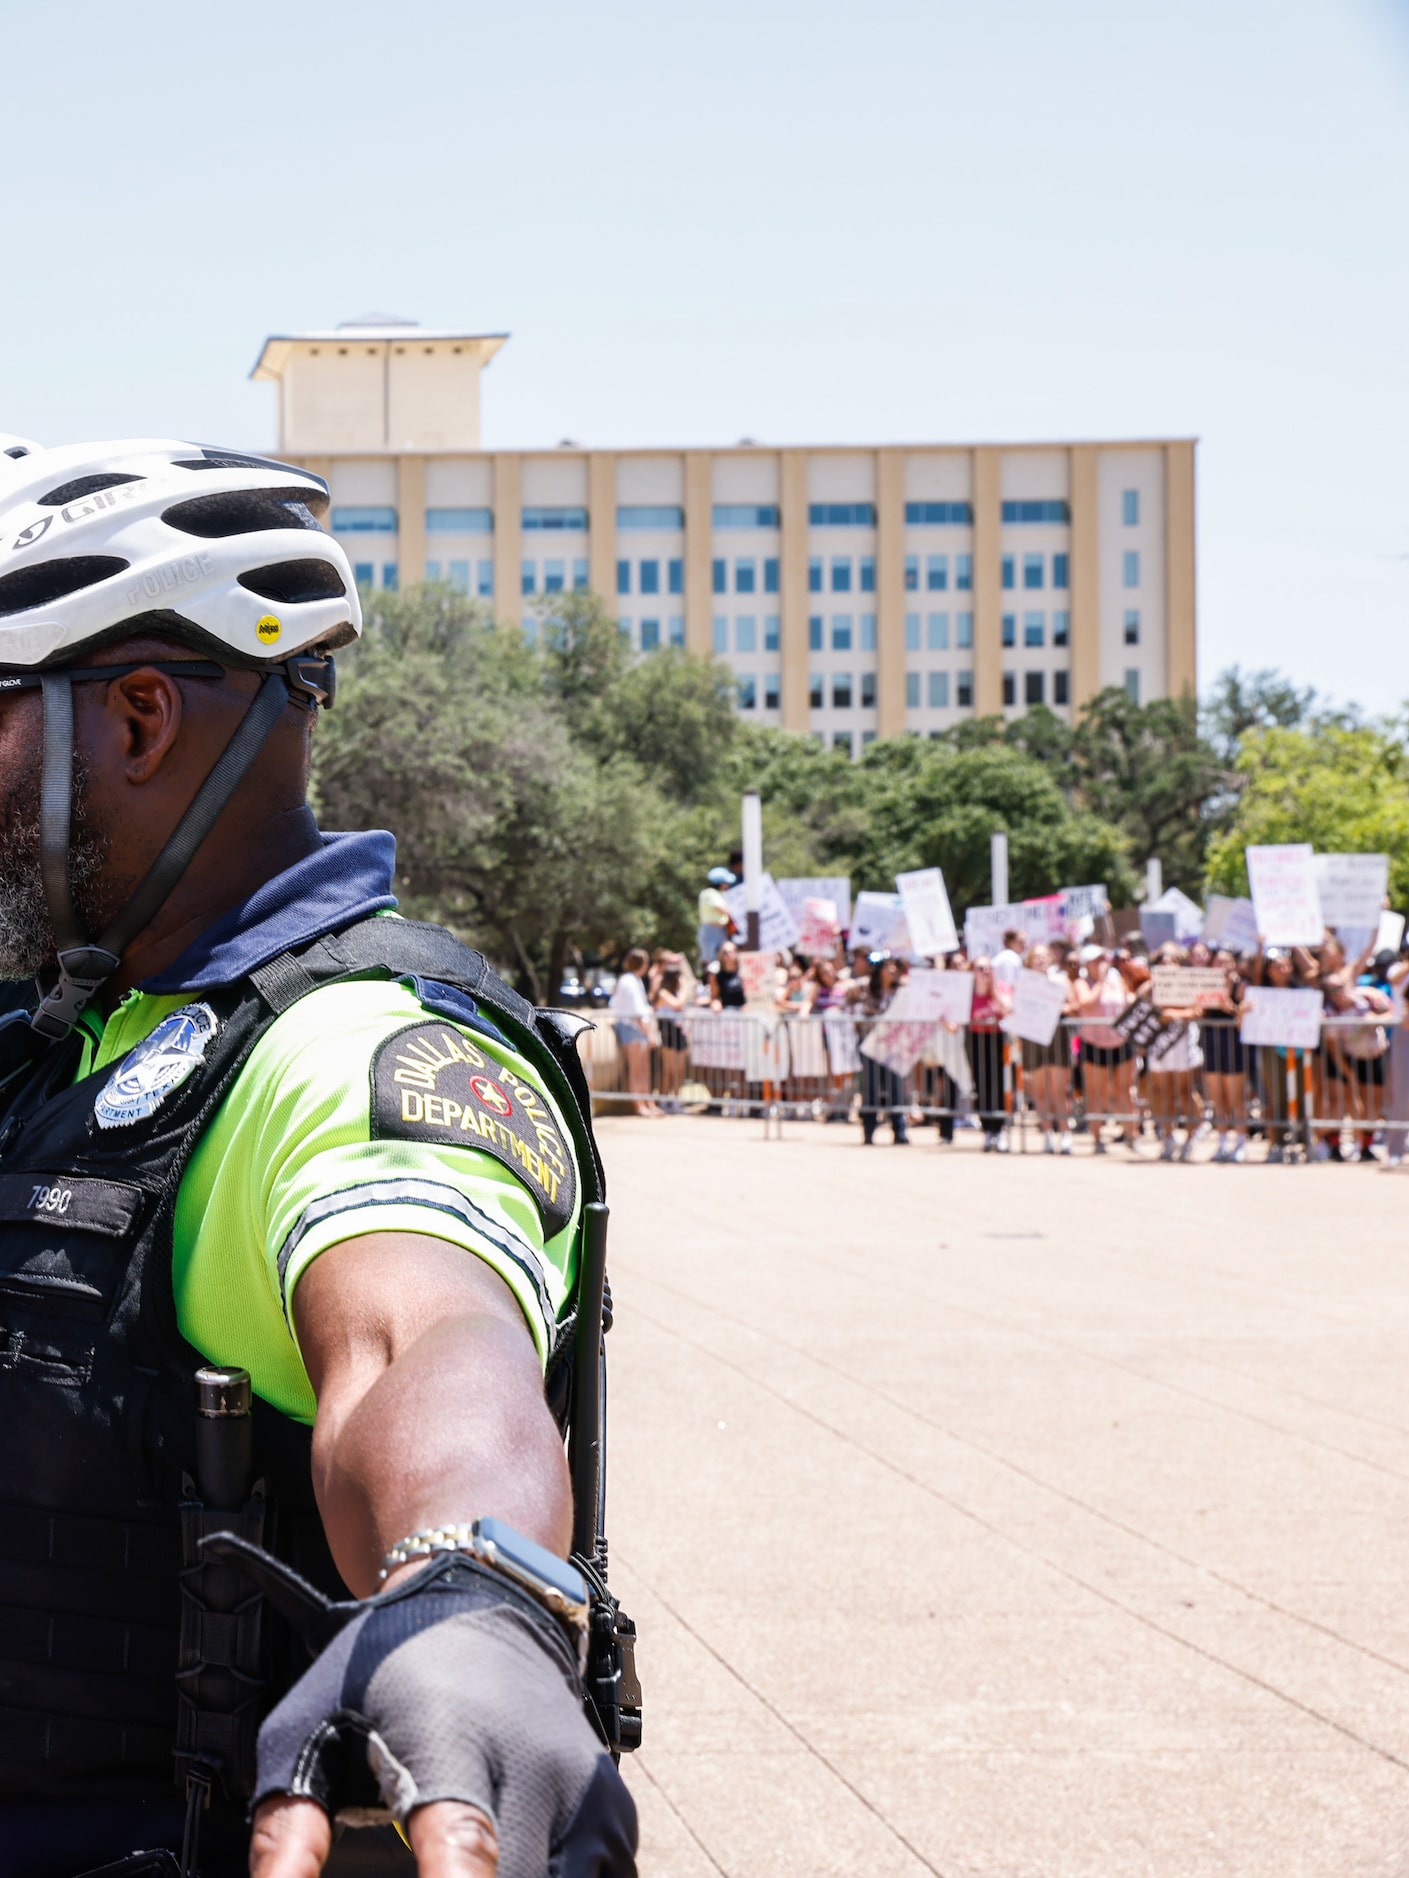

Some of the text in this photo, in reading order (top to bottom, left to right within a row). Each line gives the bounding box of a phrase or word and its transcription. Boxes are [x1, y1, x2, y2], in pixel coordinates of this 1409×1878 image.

[2, 678, 22, 688] GLOVE
[394, 1032, 566, 1178] DALLAS POLICE
[401, 1087, 562, 1205] DEPARTMENT
[26, 1184, 72, 1214] 7990
